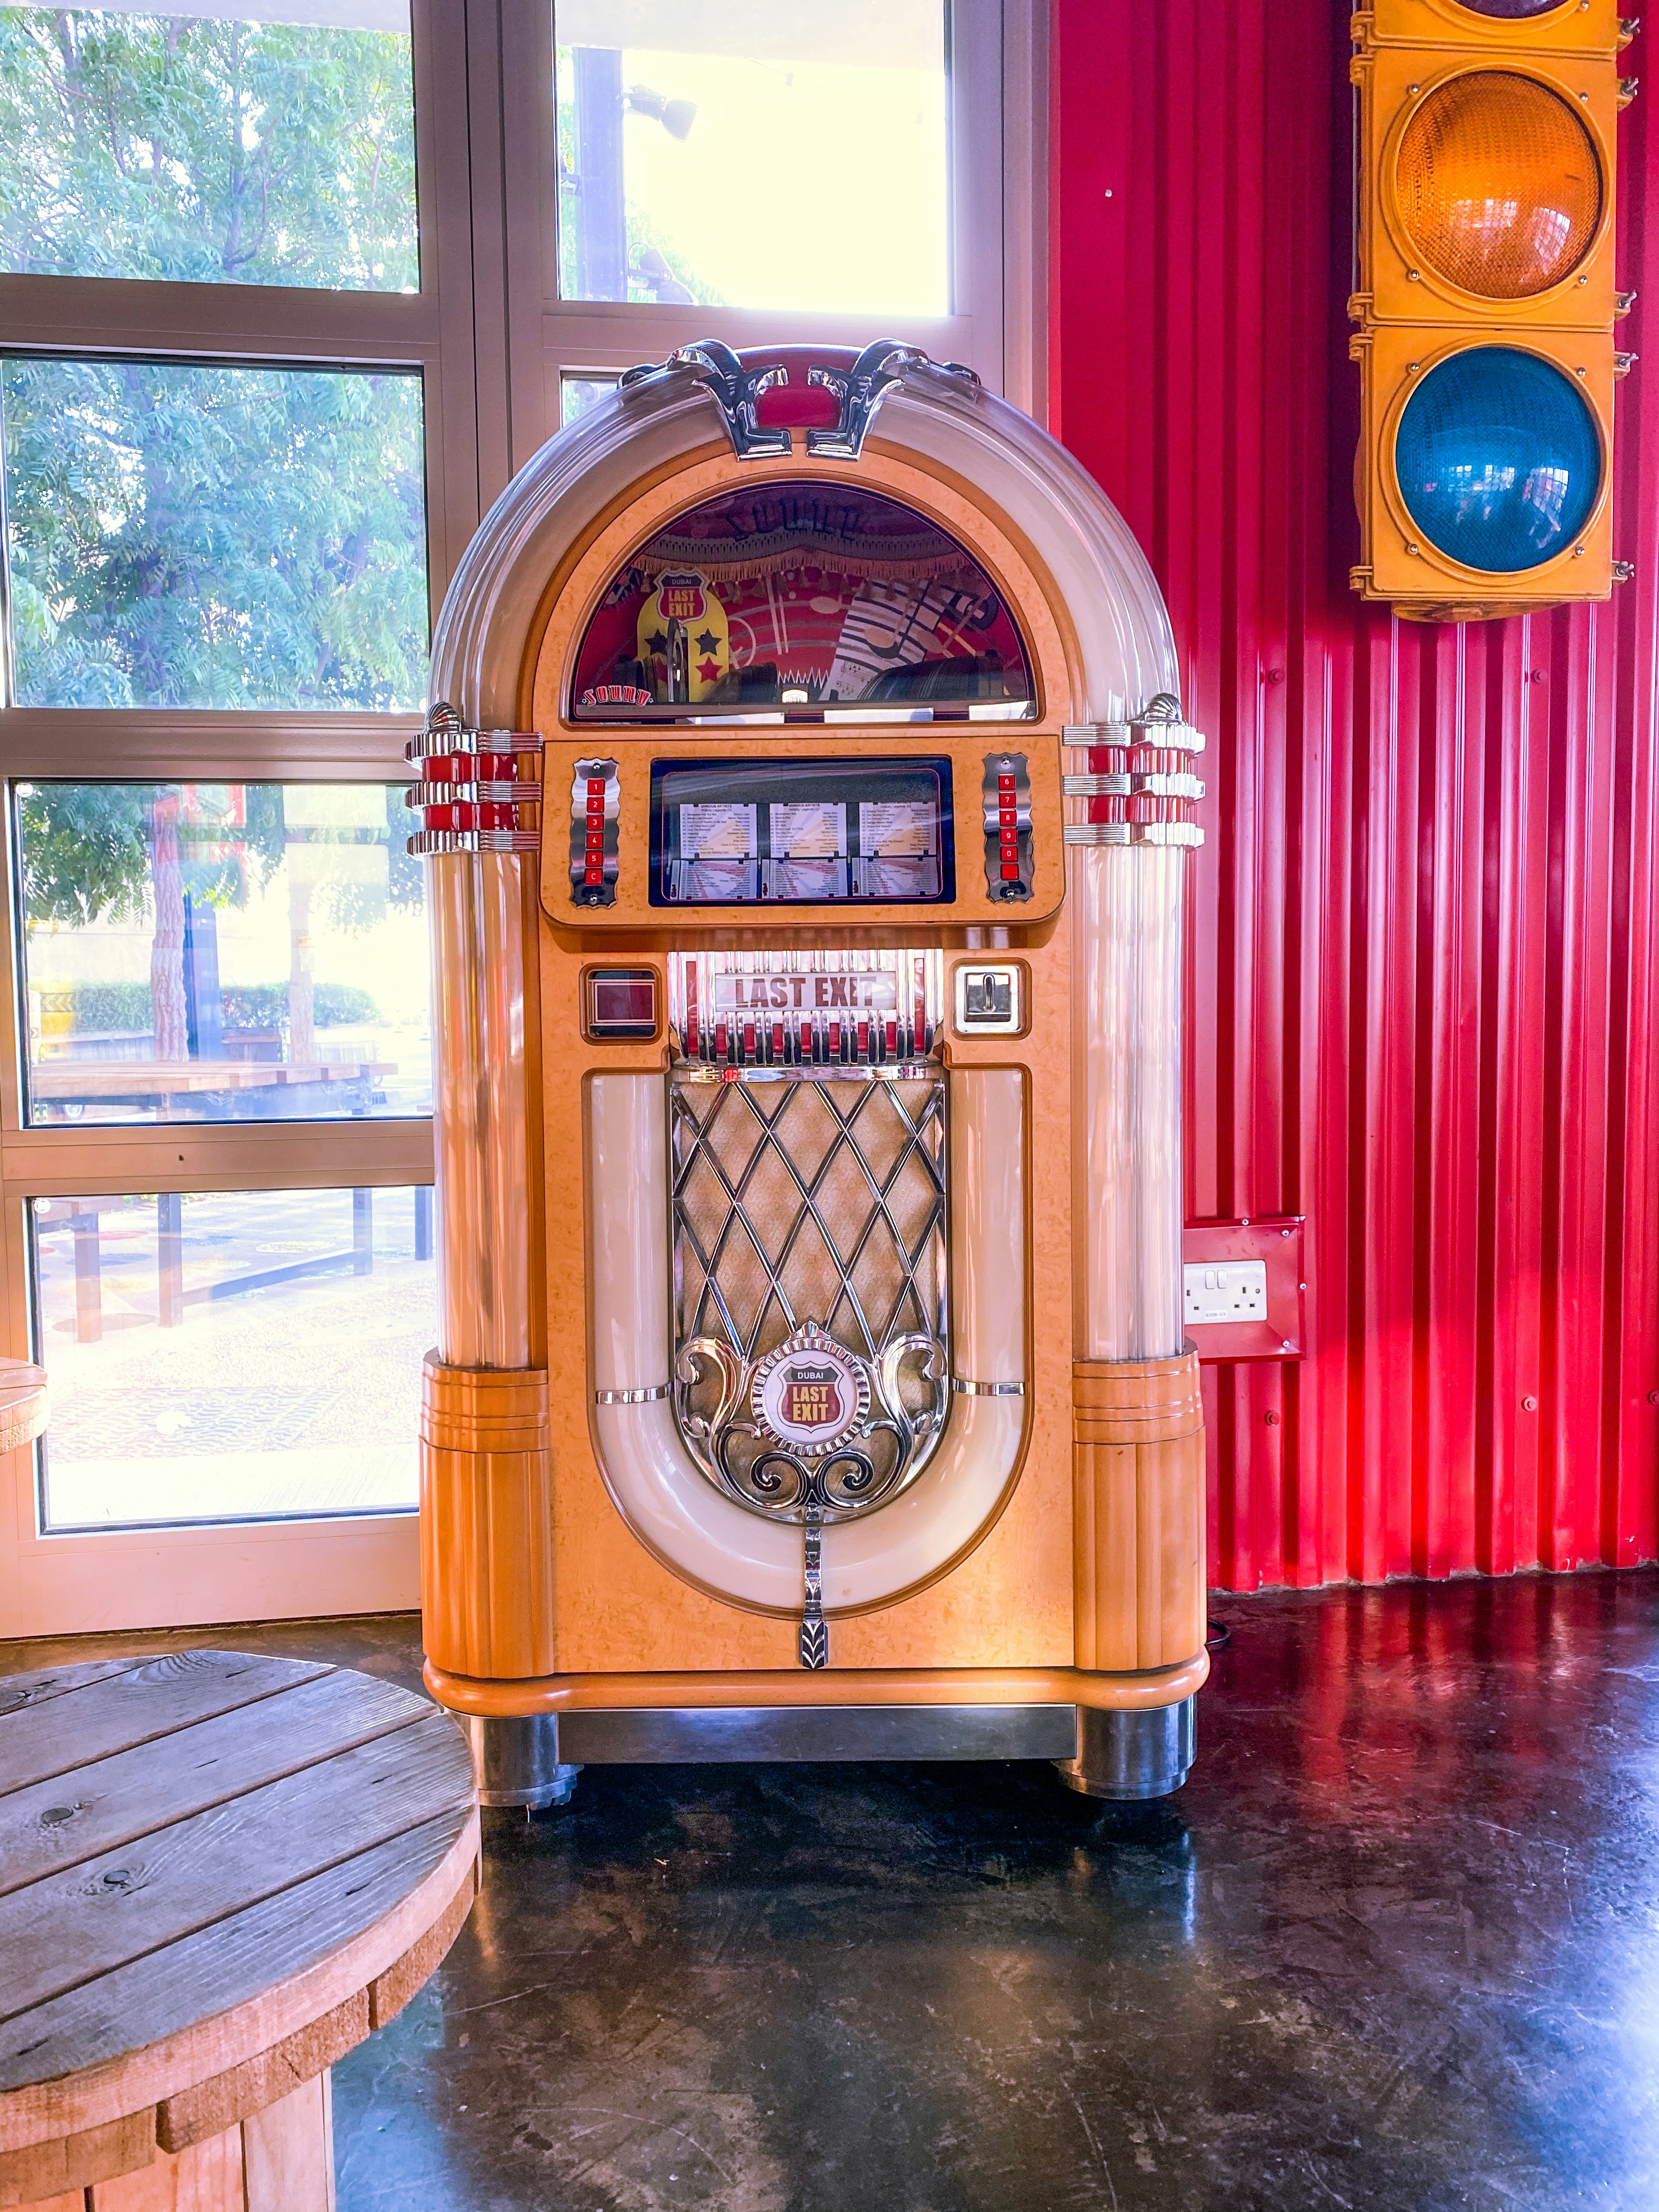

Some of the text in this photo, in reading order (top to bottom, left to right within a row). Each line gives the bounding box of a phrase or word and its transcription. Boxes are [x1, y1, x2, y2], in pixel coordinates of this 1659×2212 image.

[668, 590, 695, 602] LAST
[668, 602, 695, 616] EXIT
[583, 685, 651, 707] SOUND
[735, 977, 877, 1008] LAST EXIT
[793, 1386, 828, 1402] LAST
[793, 1403, 828, 1421] EXIT
